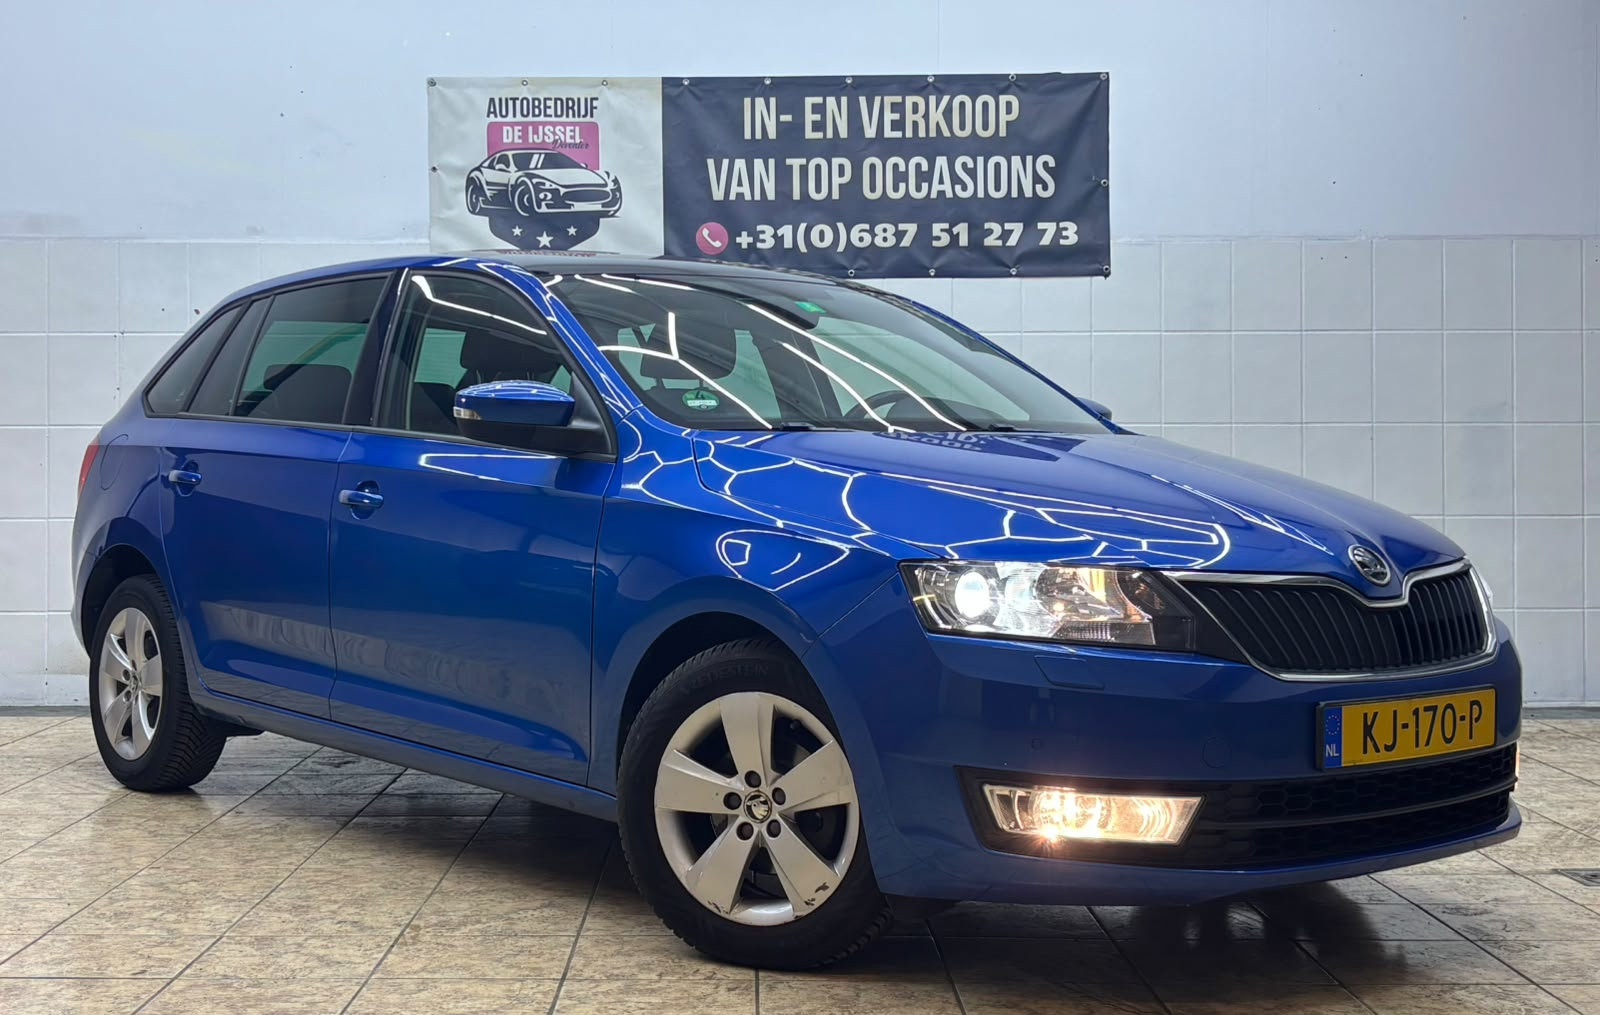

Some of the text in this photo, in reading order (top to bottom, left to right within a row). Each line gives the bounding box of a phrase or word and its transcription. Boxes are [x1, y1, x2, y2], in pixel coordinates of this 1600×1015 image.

[486, 97, 599, 118] AUTOBEDRIJF
[743, 94, 1020, 140] IN- EN VERKOOP
[502, 125, 583, 143] DE IJSSEL
[706, 155, 1056, 201] VAN TOP OCCASIONS
[735, 221, 1079, 252] +31(0)687 51 27 73
[1362, 700, 1482, 755] KJ-170-P
[1325, 744, 1340, 757] NL
